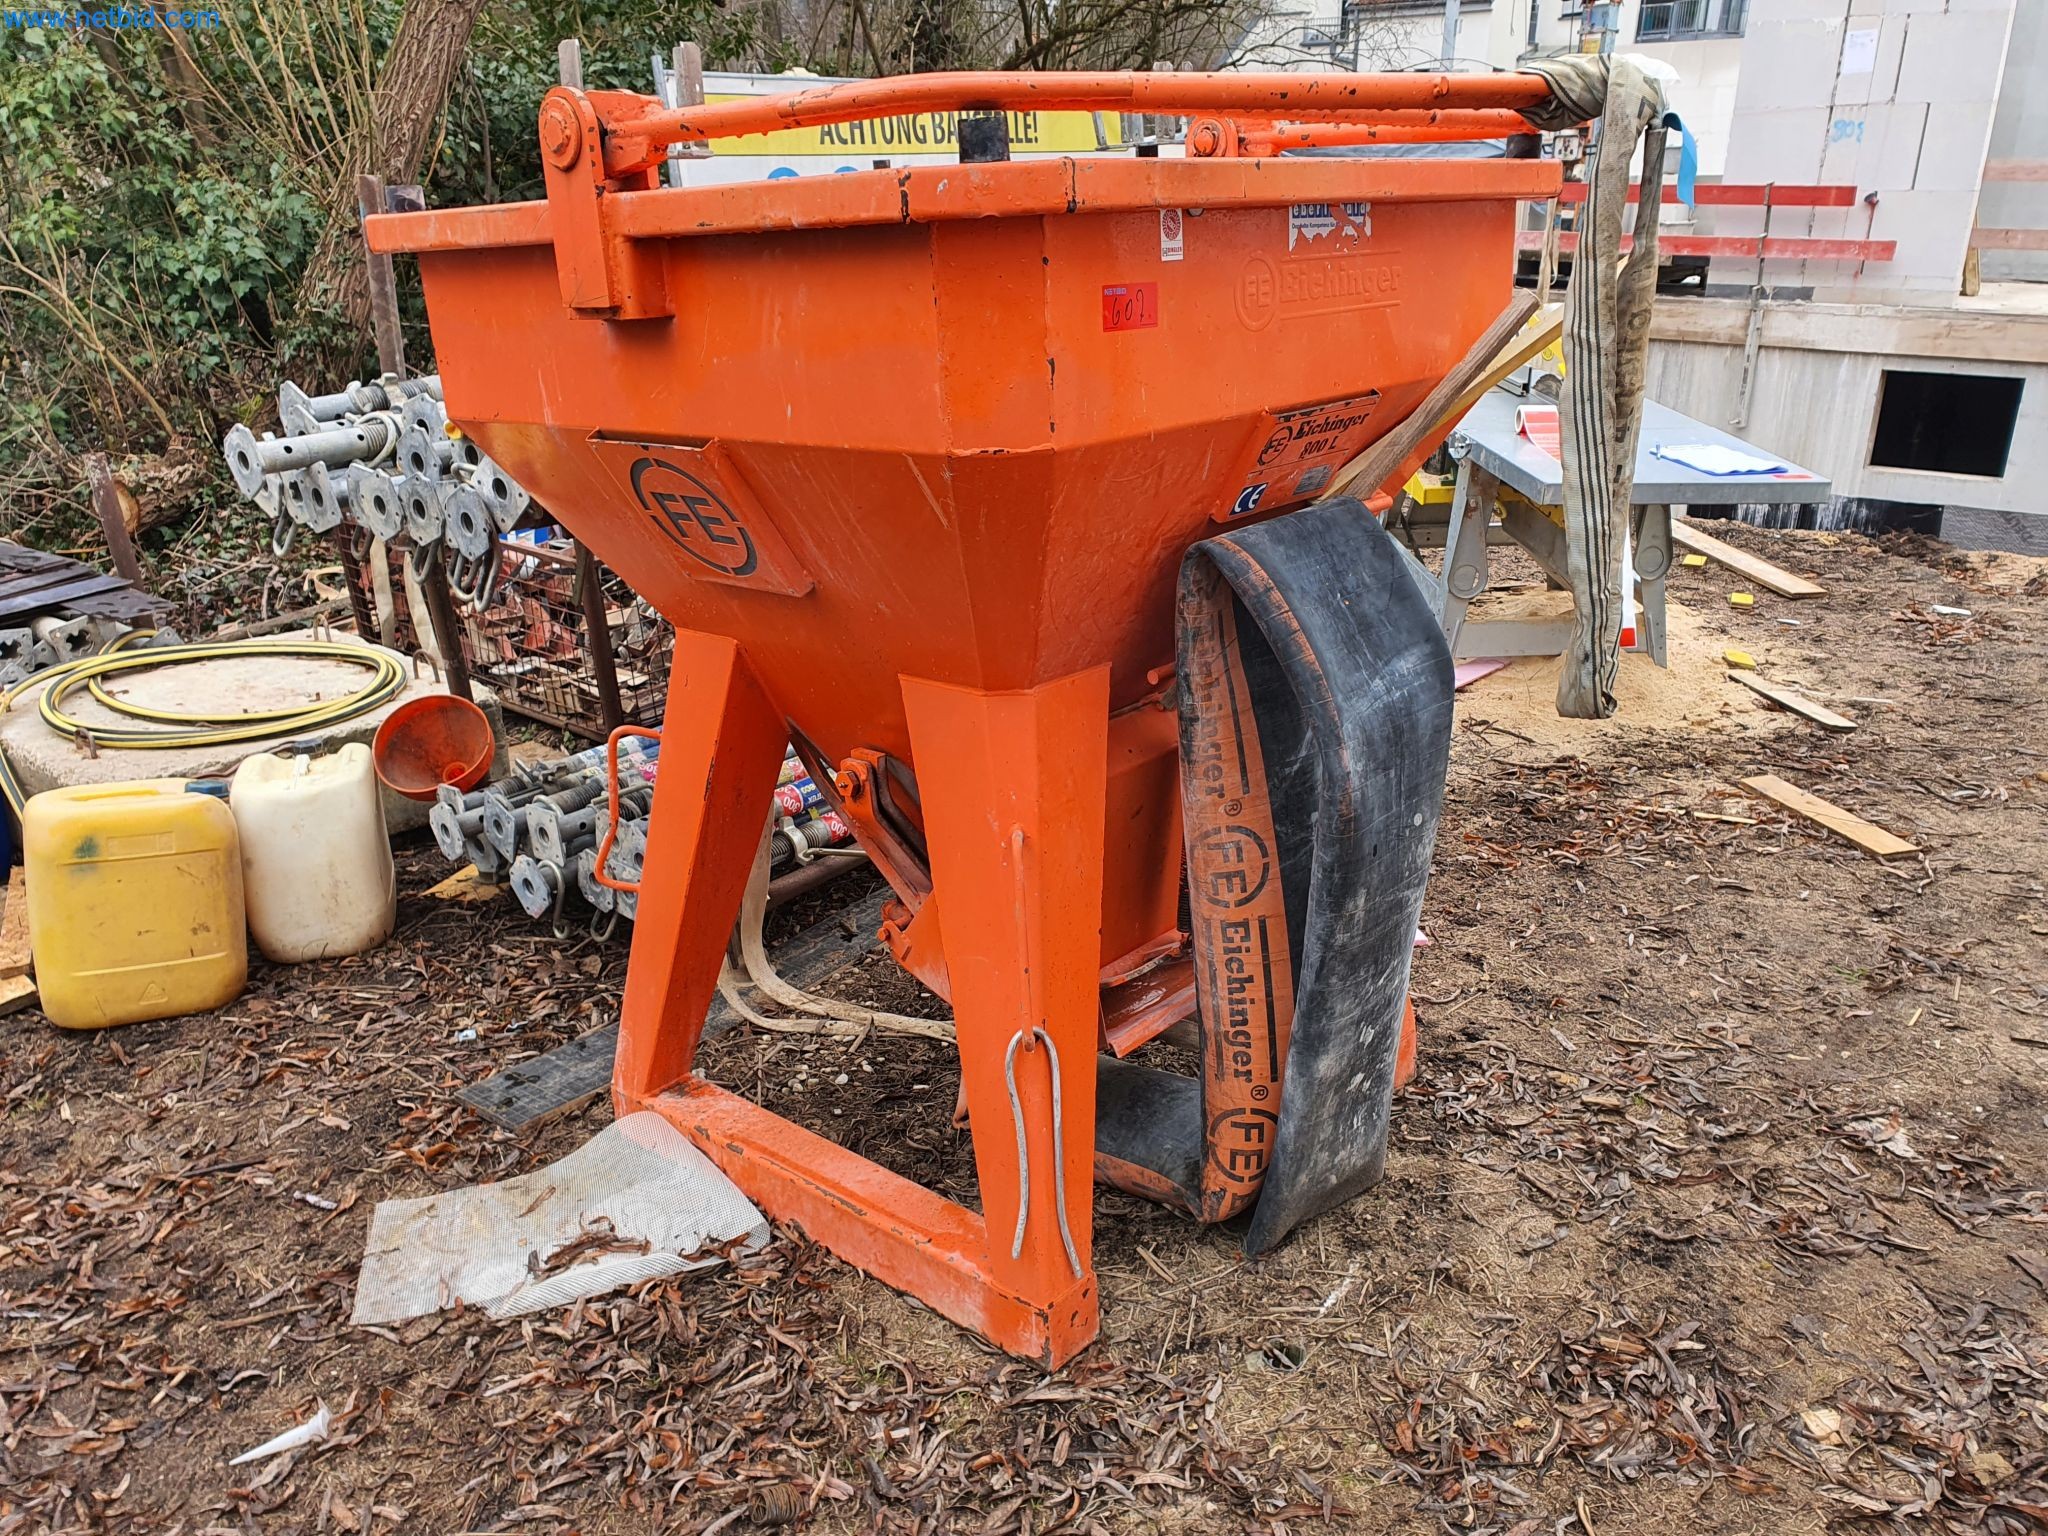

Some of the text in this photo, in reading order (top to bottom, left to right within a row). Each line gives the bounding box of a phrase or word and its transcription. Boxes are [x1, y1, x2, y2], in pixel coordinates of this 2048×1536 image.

[820, 111, 927, 146] ACHTUNG
[1293, 412, 1370, 441] Eichinger
[1300, 435, 1339, 458] 800 L
[650, 491, 740, 546] FE
[783, 796, 801, 813] 300
[831, 820, 848, 837] 300
